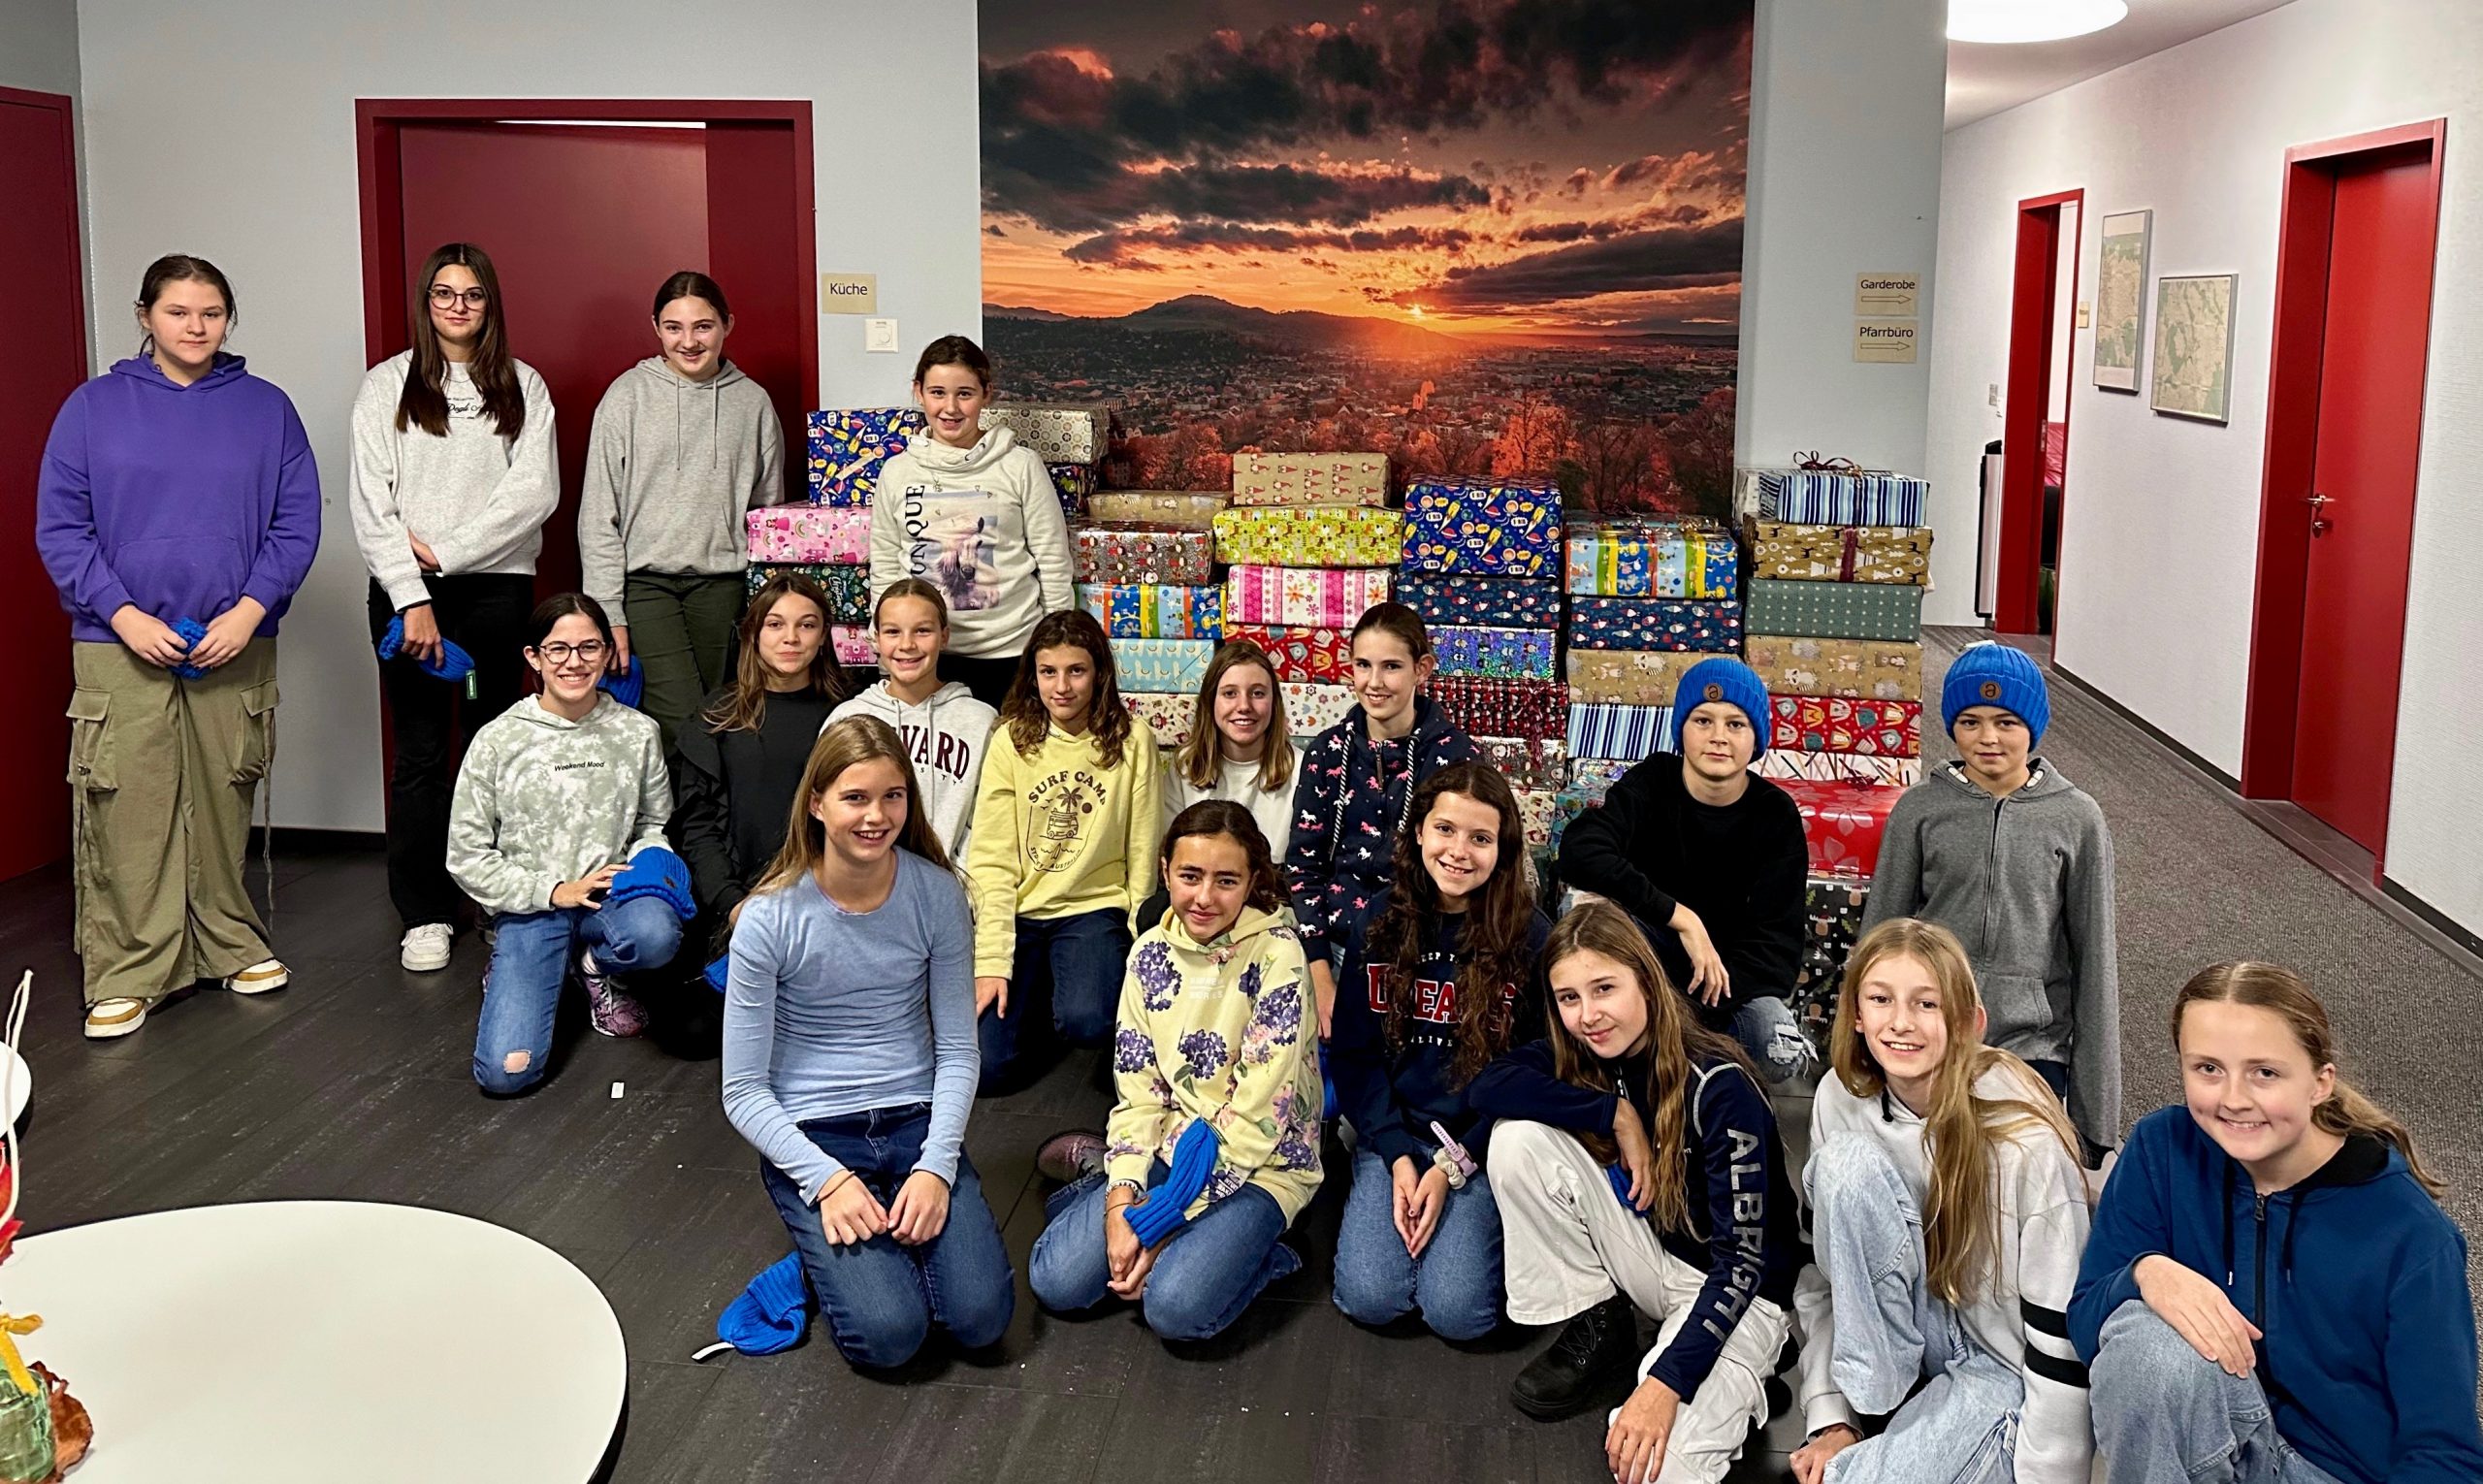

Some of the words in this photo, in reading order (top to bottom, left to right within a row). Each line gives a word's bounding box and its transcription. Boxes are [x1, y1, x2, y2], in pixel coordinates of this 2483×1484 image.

[830, 282, 868, 295] Küche
[1860, 279, 1916, 289] Garderobe
[1859, 327, 1914, 338] Pfarrbüro
[894, 725, 970, 781] VARD
[554, 761, 586, 772] Weekend
[1028, 770, 1069, 804] SURF
